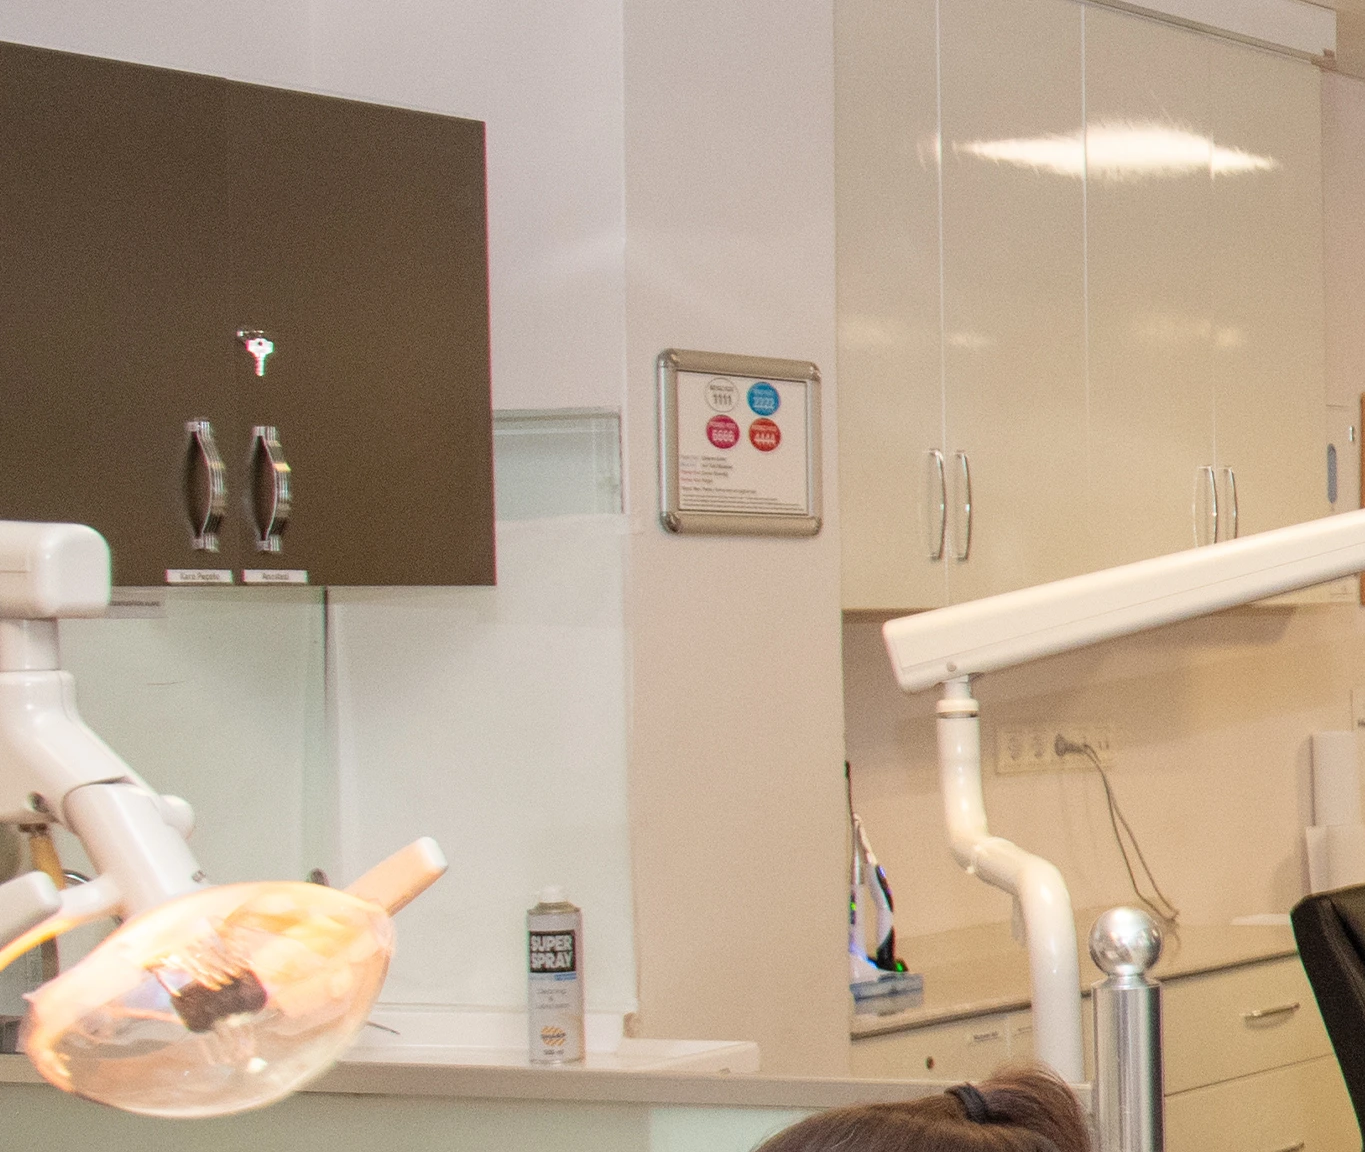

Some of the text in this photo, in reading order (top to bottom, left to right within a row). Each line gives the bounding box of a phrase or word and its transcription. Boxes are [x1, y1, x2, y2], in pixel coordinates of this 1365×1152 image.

[713, 393, 732, 405] 1111
[531, 935, 572, 951] SUPER
[531, 952, 572, 968] SPRAY
